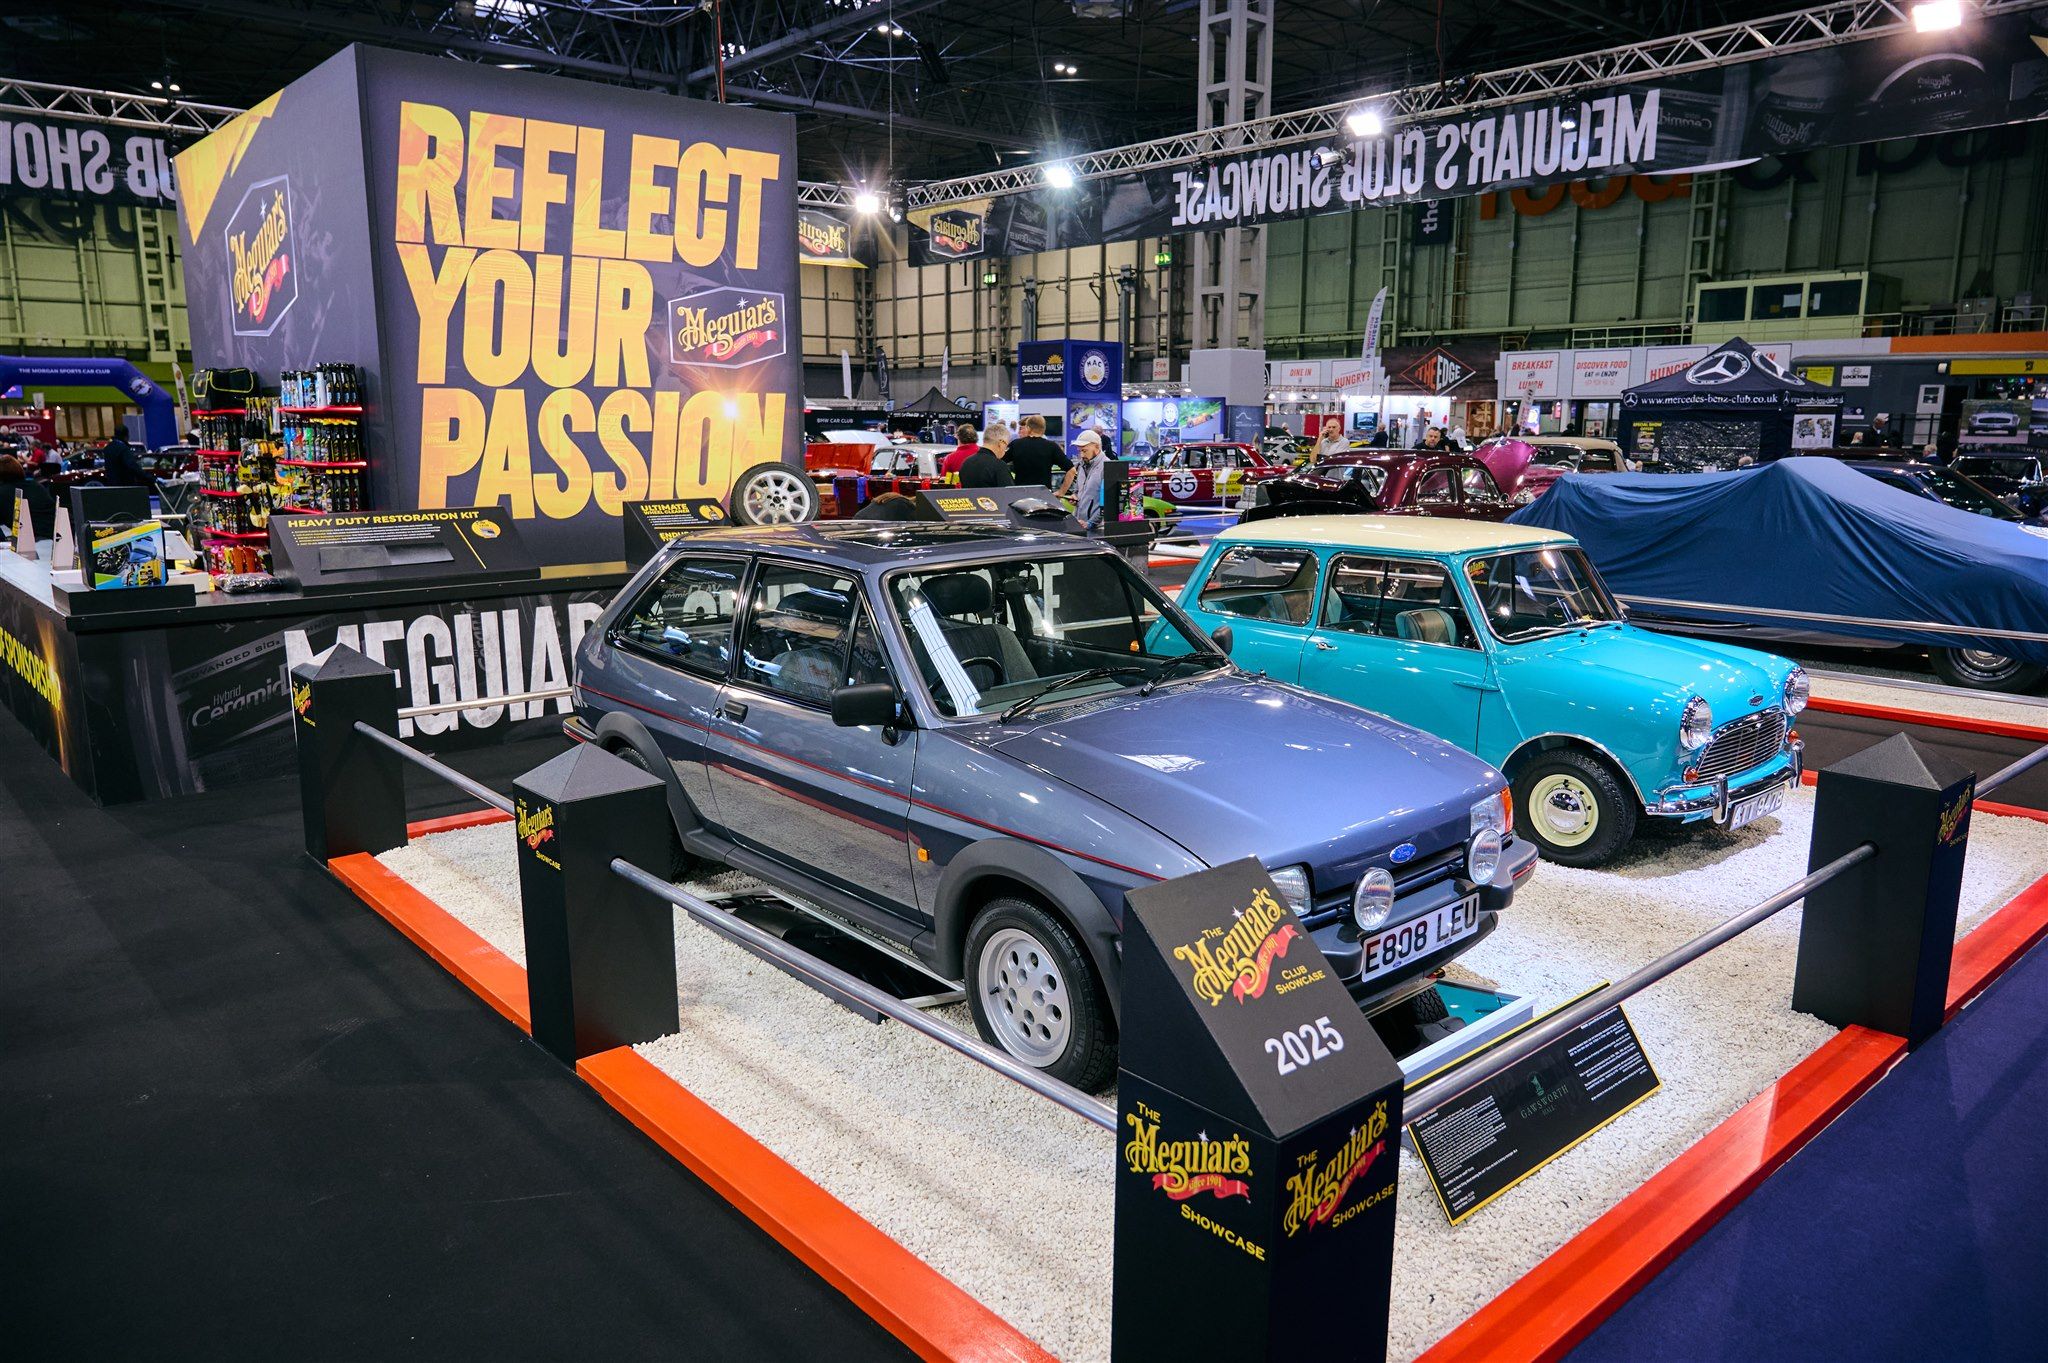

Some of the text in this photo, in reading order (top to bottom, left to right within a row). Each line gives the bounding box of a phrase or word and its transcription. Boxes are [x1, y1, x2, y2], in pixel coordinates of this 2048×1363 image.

[396, 101, 780, 270] REFLECT
[229, 189, 289, 316] Meguiar's
[397, 242, 654, 388] YOUR
[677, 297, 778, 357] Meguiar's
[1021, 363, 1065, 373] SHELSLEY WALSH
[1289, 368, 1312, 377] DINE IN
[1334, 370, 1371, 388] HUNGRY?
[1414, 354, 1461, 391] THE EDGE
[1512, 360, 1554, 371] BREAKFAST
[1576, 360, 1628, 371] DISCOVER FOOD
[1641, 393, 1778, 405] www.mercedes-benz-club.co.uk
[418, 387, 787, 519] PASSION
[1170, 477, 1196, 493] 35
[288, 511, 480, 528] HEAVY DUTY RESTORATION KIT
[640, 503, 687, 511] ULTIMATE
[213, 684, 242, 706] Hybrid
[516, 803, 554, 846] Meguiar's
[535, 850, 562, 871] SHOWCASE
[1201, 926, 1224, 940] THE
[1365, 920, 1428, 975] E808
[1437, 897, 1478, 942] LEU
[1174, 888, 1282, 1006] Meguiar's
[1275, 969, 1326, 996] SHOWCASE
[1264, 1015, 1345, 1076] 2025
[1136, 1101, 1161, 1124] THE
[1520, 1084, 1569, 1119] GAWSWORTH
[1125, 1112, 1251, 1193] Meguiar's
[1296, 1149, 1318, 1168] THE
[1206, 1175, 1222, 1187] 1901
[1283, 1100, 1388, 1237] Meguiar's
[1332, 1183, 1395, 1228] SHOWCASE
[1180, 1203, 1266, 1262] SHOWCASE
